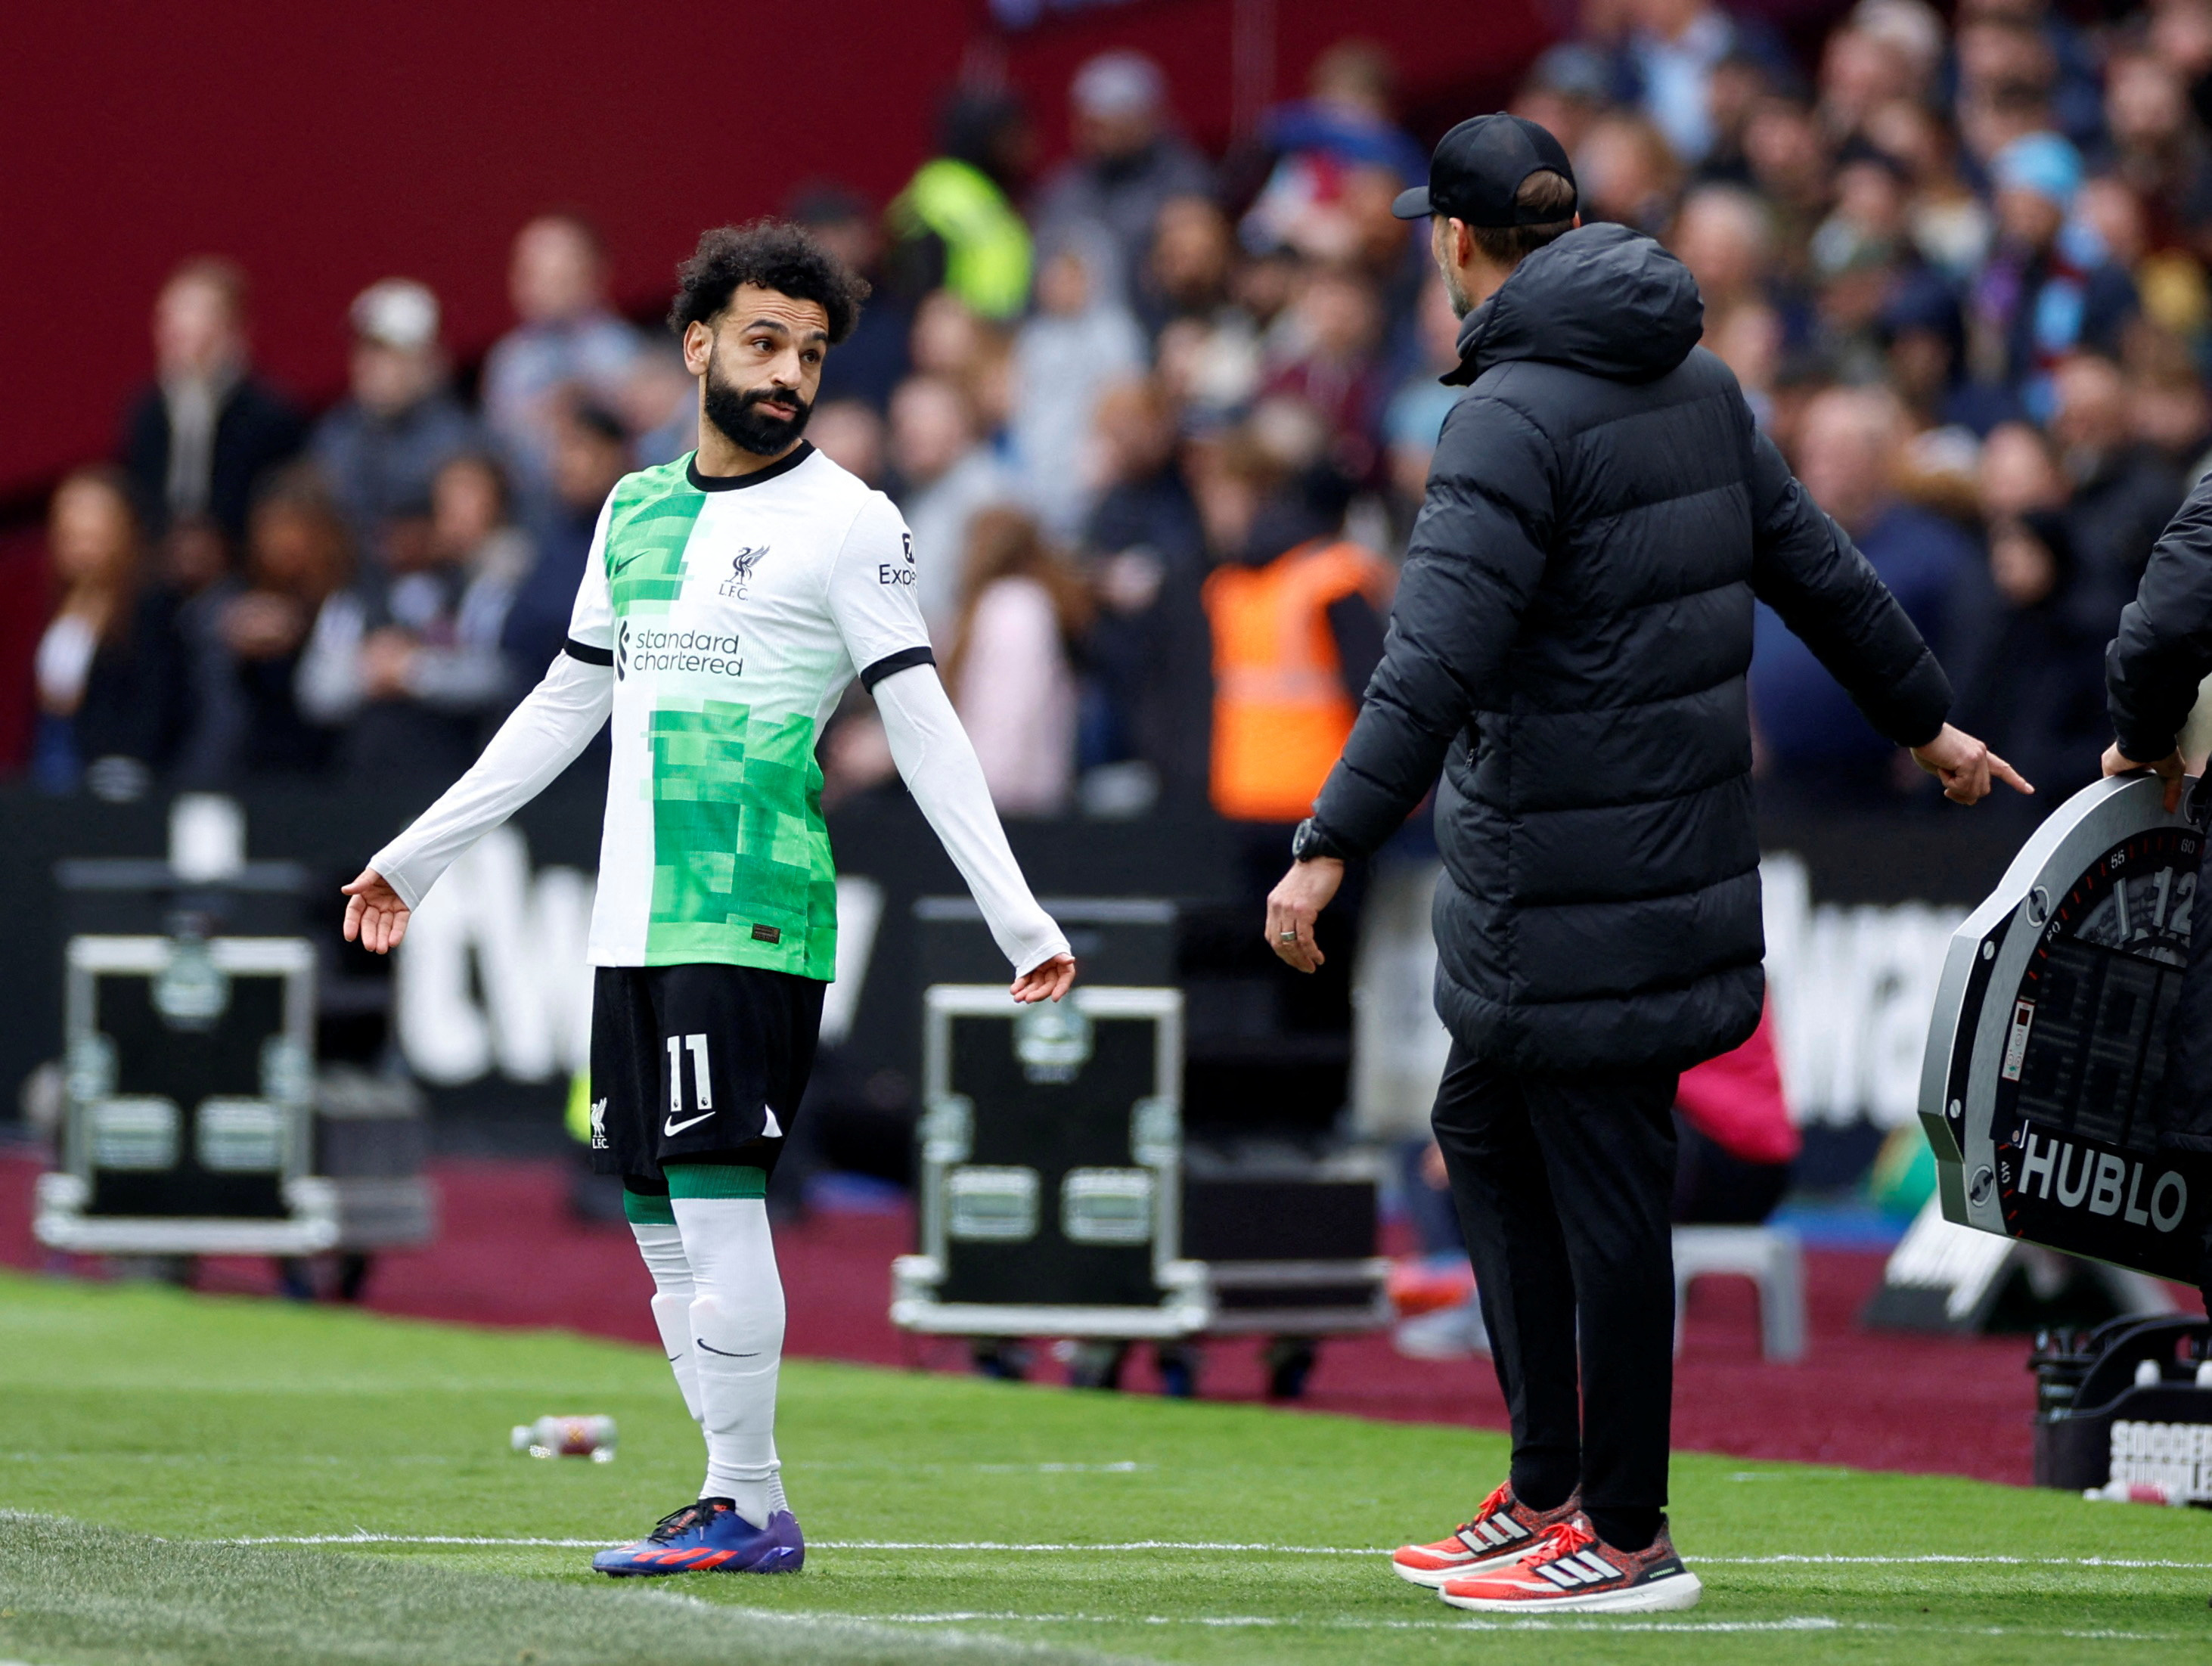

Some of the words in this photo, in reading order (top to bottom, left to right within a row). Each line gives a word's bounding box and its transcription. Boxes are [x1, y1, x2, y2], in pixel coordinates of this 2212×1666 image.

[636, 628, 739, 654] standard
[634, 650, 743, 678] chartered
[2111, 849, 2125, 869] 55
[2180, 838, 2196, 855] 60
[2152, 866, 2198, 936] 12
[666, 1033, 712, 1112] 11
